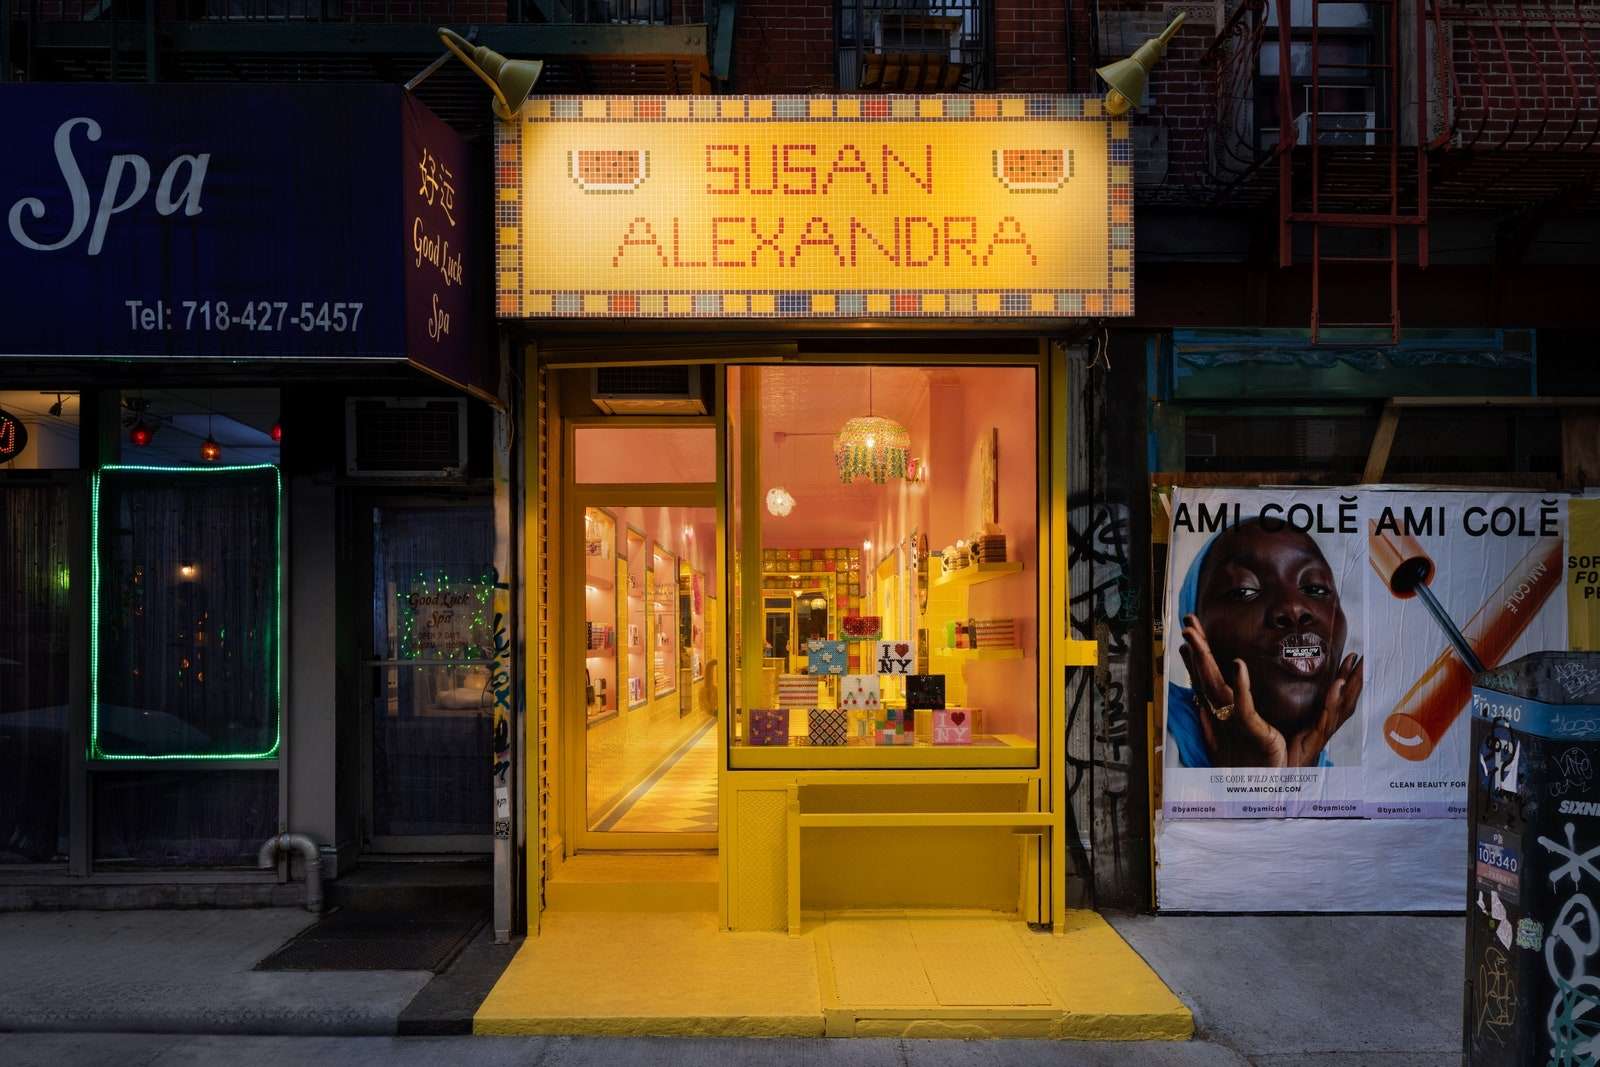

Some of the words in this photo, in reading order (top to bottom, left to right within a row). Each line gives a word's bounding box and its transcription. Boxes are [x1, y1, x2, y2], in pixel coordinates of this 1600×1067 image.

[706, 145, 932, 194] SUSAN
[8, 117, 211, 255] Spa
[413, 218, 440, 268] Good
[440, 241, 463, 287] Luck
[612, 217, 1037, 267] ALEXANDRA
[126, 300, 173, 330] Tel:
[183, 301, 363, 332] 718-427-5457
[428, 293, 451, 344] Spa
[1173, 503, 1240, 533] AMI
[1375, 506, 1445, 537] AMI
[1528, 561, 1548, 585] AMI
[882, 644, 891, 658] I
[877, 659, 912, 673] NY
[1479, 702, 1521, 723] 103340
[1210, 775, 1224, 783] USE
[1225, 775, 1245, 783] CODE
[1247, 775, 1267, 783] WILD
[1269, 775, 1279, 783] AT
[1280, 774, 1318, 783] CHECKOUT
[1389, 781, 1415, 789] CLEAN
[1171, 806, 1216, 814] @byamicole
[1242, 805, 1287, 813] @byamicole
[1312, 804, 1357, 812] @byamicole
[1377, 806, 1422, 814] @byamicole
[1478, 847, 1518, 872] 103340
